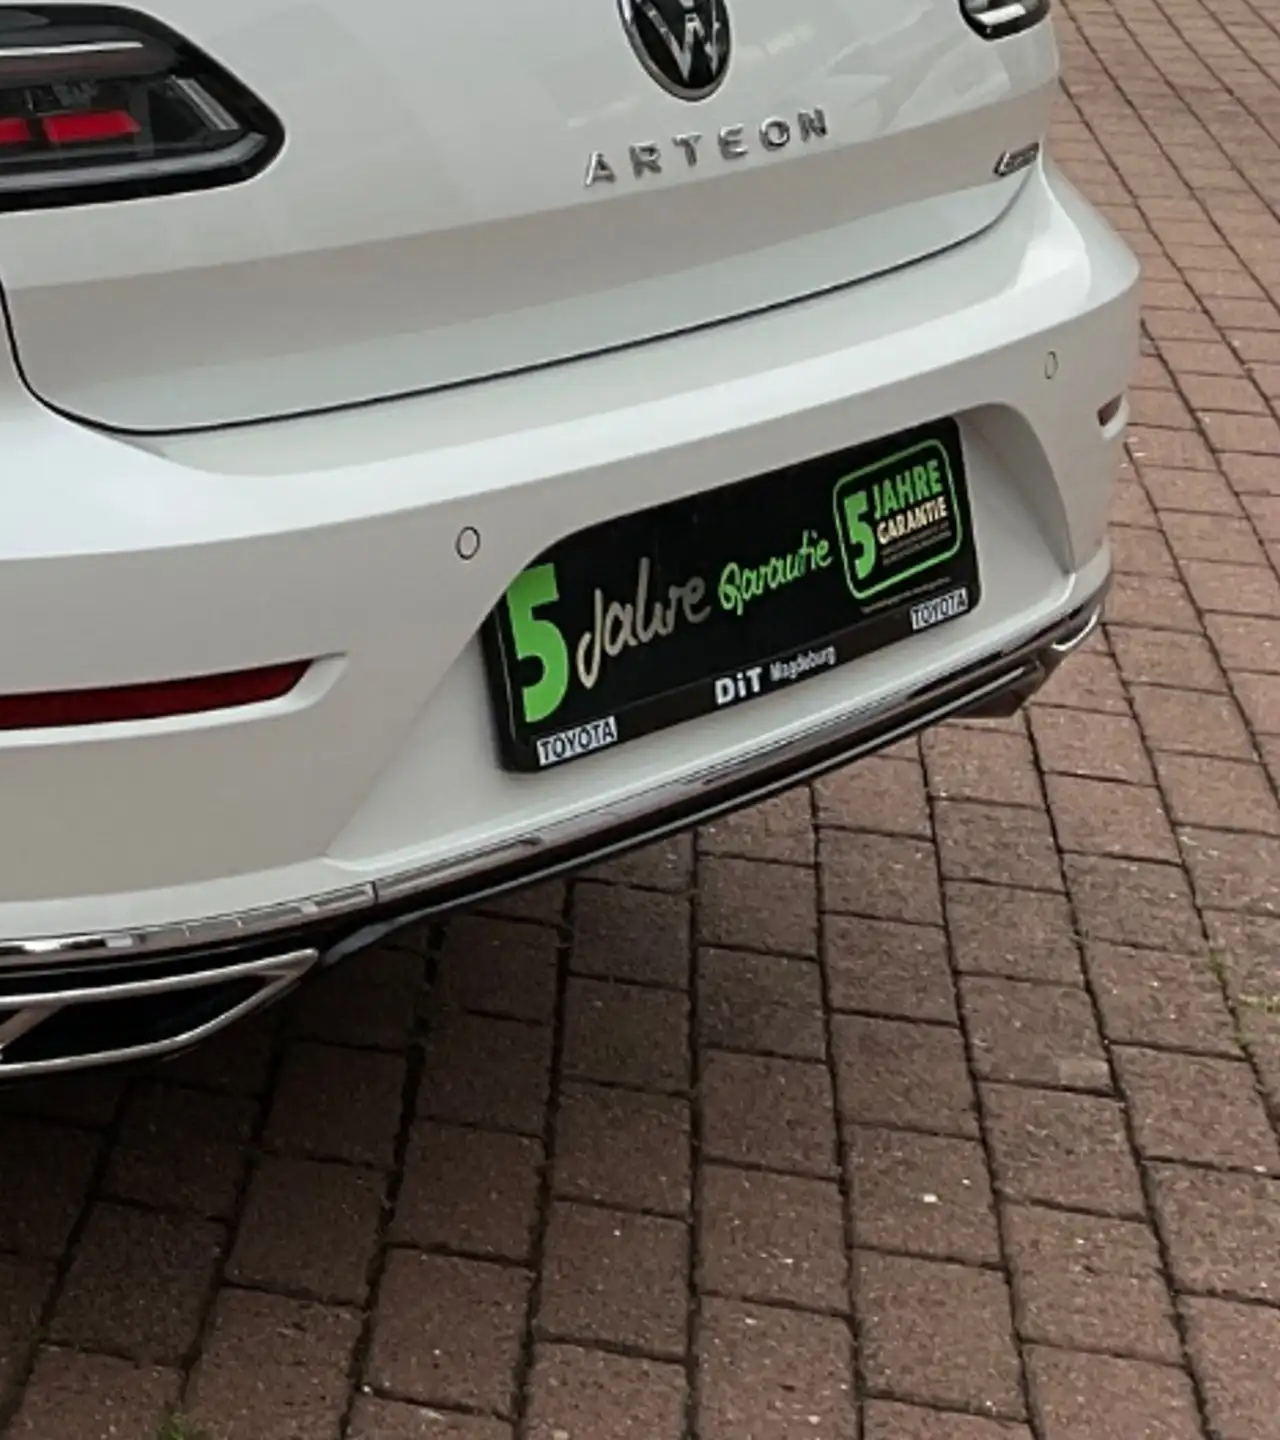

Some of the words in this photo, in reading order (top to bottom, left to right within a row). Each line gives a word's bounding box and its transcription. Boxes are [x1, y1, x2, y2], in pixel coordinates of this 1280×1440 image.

[584, 106, 829, 187] ARTEON
[844, 490, 876, 580] 5
[872, 460, 943, 520] JAHRE
[877, 496, 948, 544] GARANTIE
[911, 588, 968, 630] TOYOTA
[507, 563, 569, 722] 5
[576, 557, 712, 689] Jahre
[714, 667, 763, 705] DiT
[769, 645, 836, 682] Magdeburg
[539, 718, 616, 763] TOYOTA
